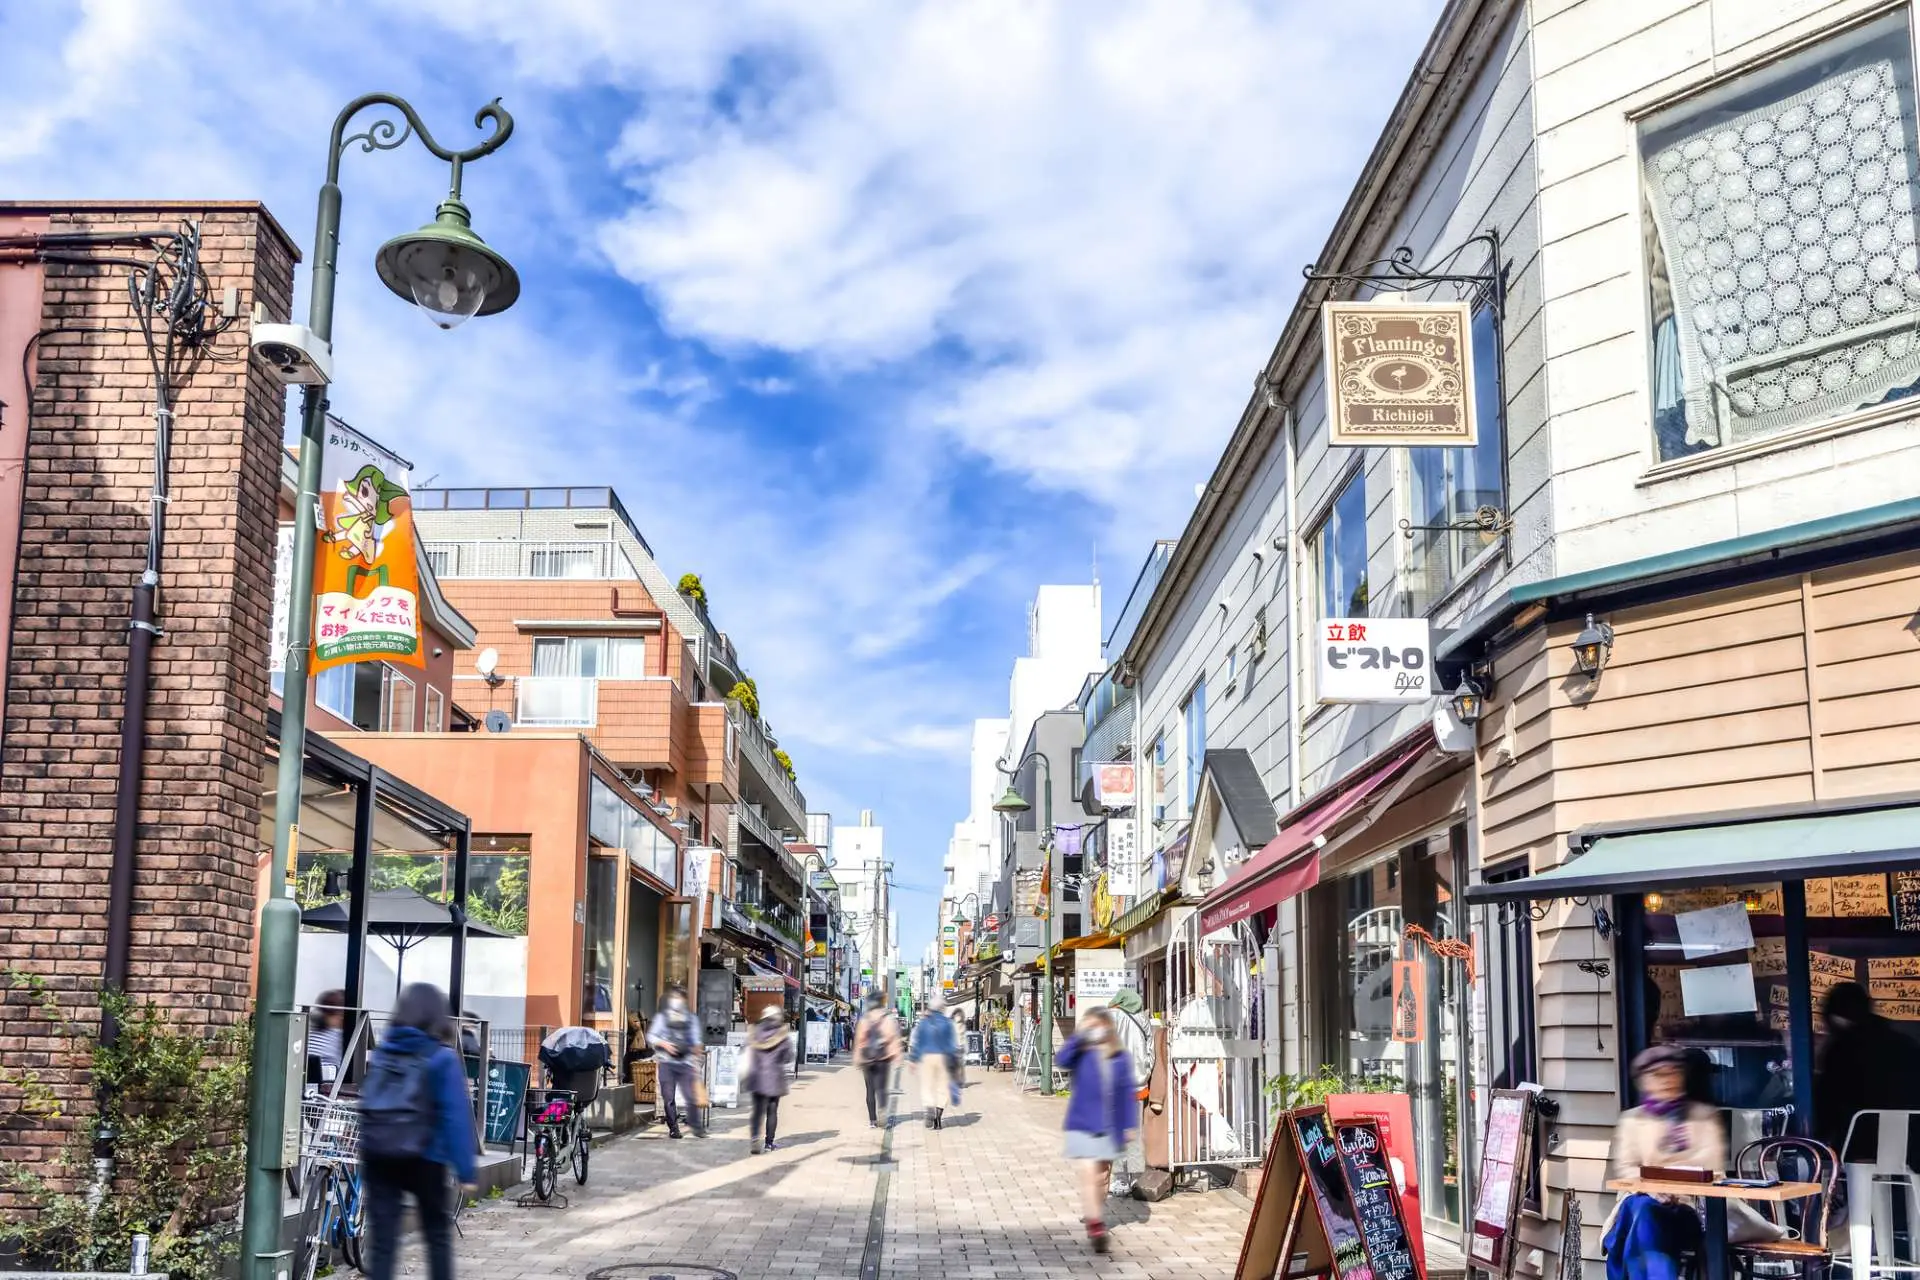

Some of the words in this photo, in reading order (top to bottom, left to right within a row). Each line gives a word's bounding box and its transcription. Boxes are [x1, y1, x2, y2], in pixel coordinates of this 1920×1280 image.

[1352, 335, 1447, 358] Flamingo
[1372, 407, 1434, 423] Kichijoji
[322, 596, 410, 620] マイッグを
[321, 611, 411, 637] お持ください
[1327, 623, 1367, 642] 立飲
[1327, 646, 1424, 669] ビストロ
[1394, 672, 1425, 695] Ryo
